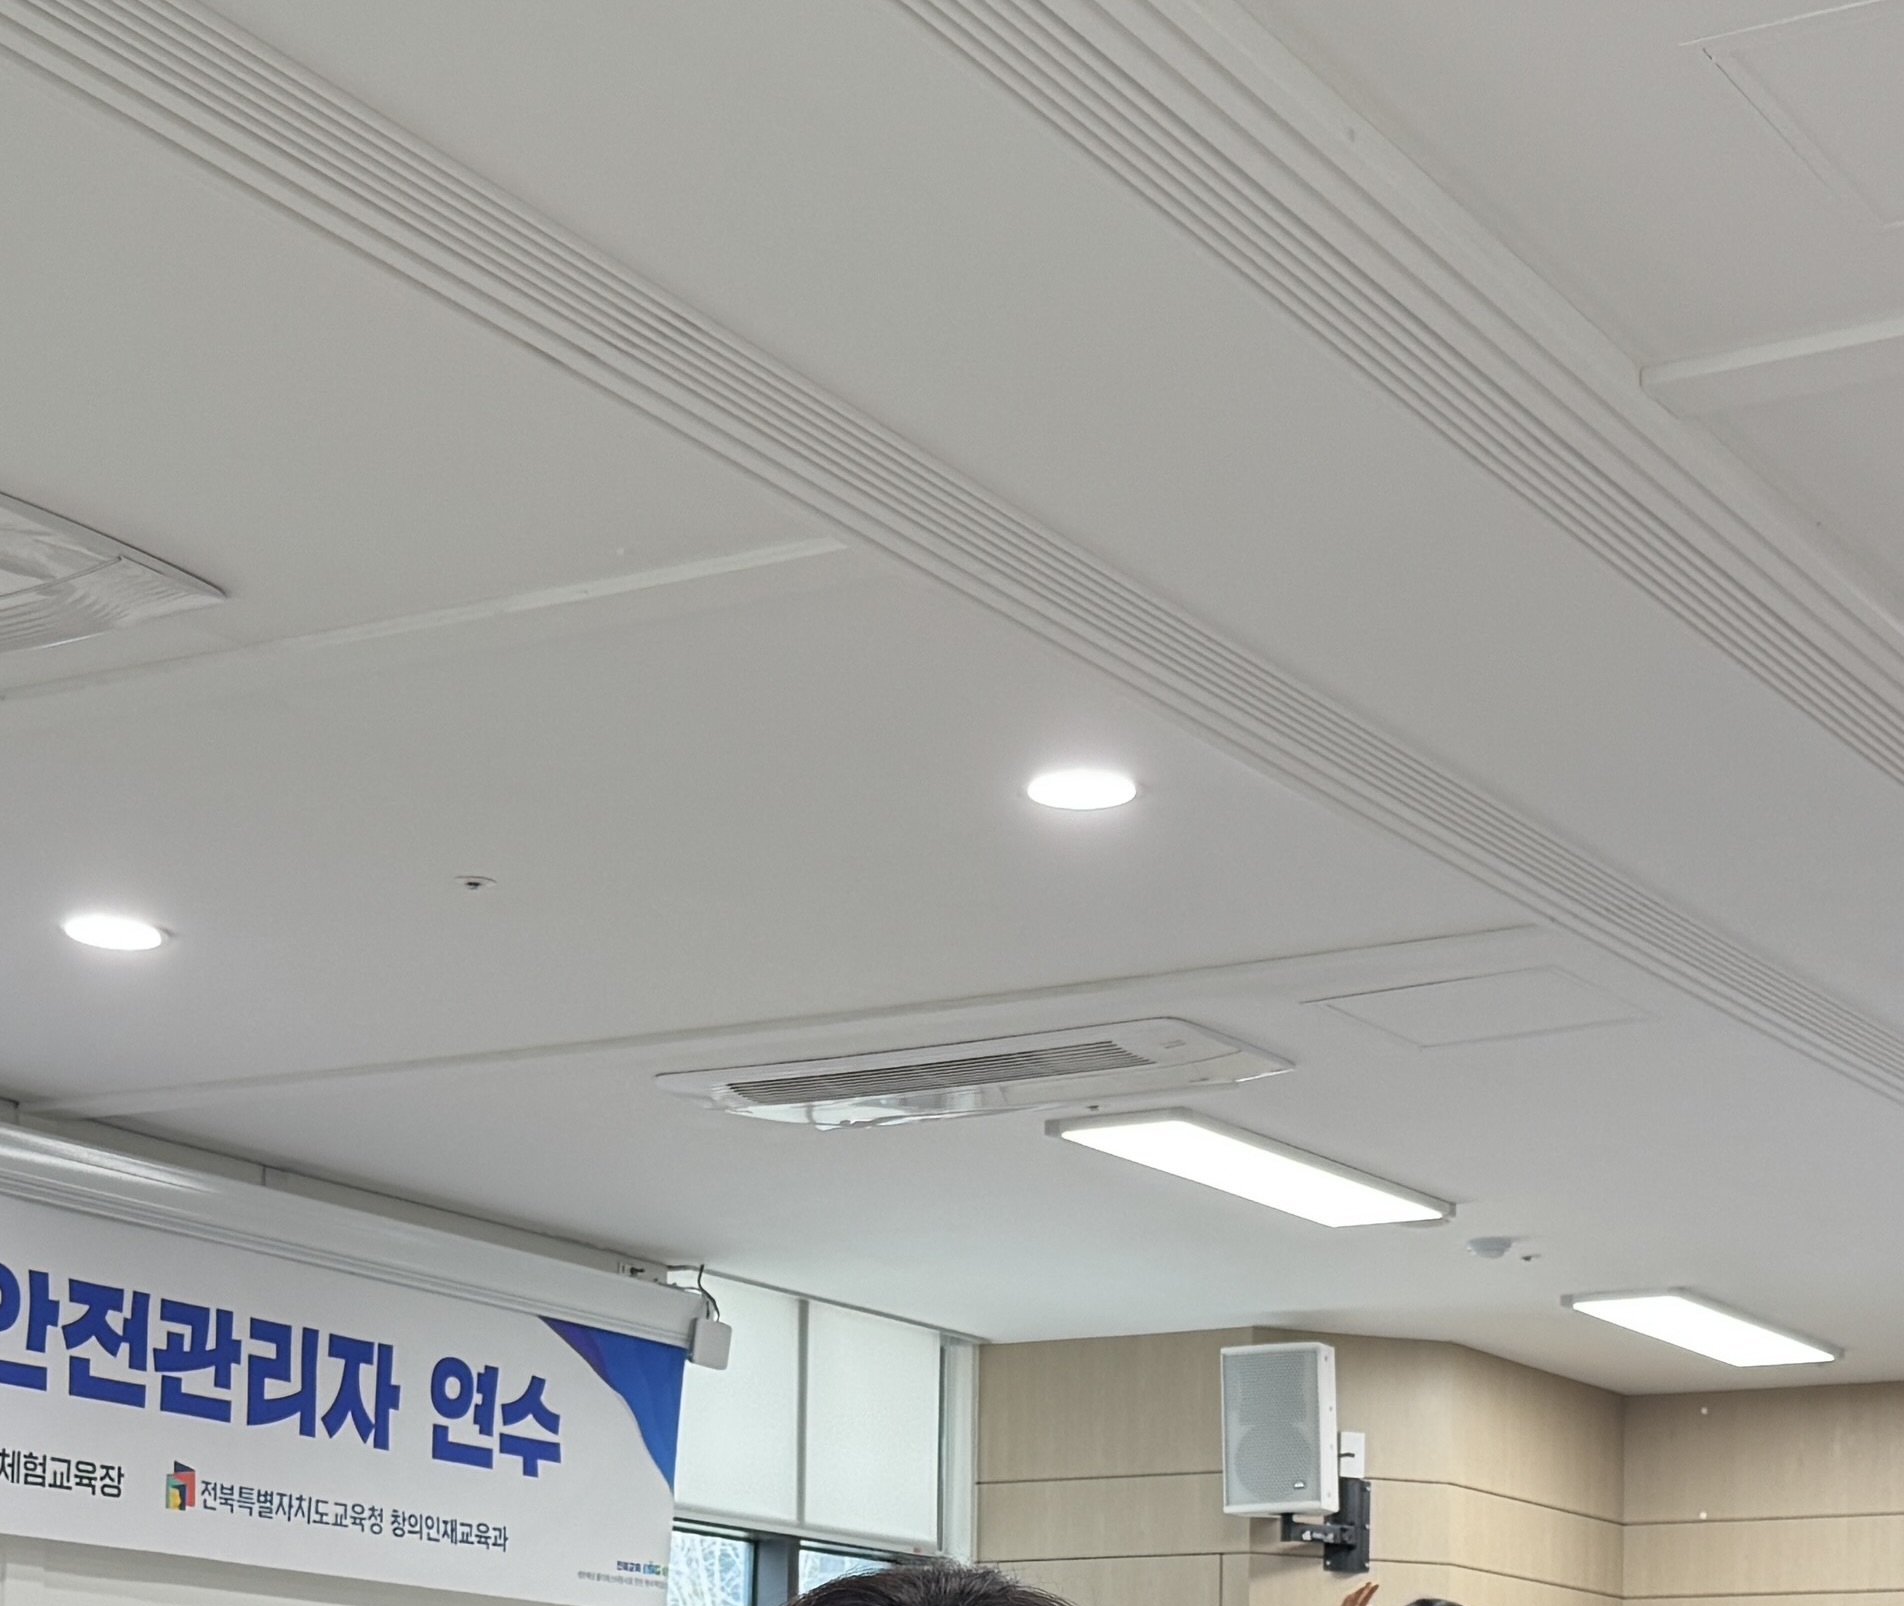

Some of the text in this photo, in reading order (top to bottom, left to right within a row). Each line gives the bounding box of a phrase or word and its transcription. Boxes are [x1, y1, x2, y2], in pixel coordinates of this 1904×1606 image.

[431, 1357, 560, 1477] 연수
[201, 1481, 508, 1552] 전북특별자치도교육청 창의인재교육과
